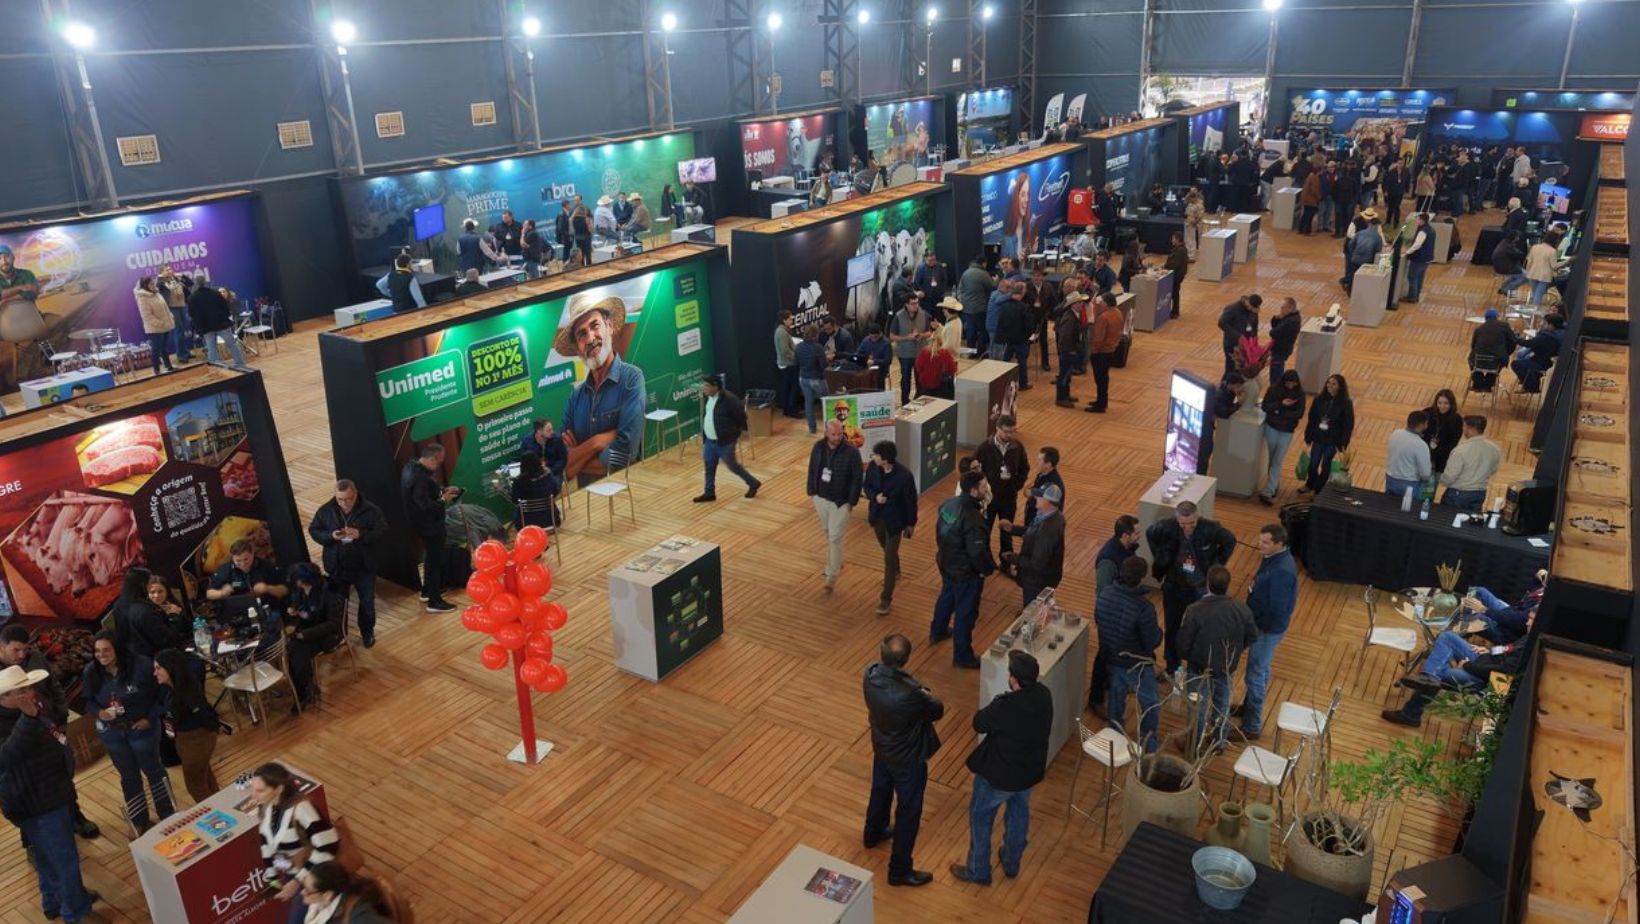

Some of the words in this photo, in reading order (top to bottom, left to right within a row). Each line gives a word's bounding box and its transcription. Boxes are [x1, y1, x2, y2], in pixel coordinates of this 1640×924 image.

[753, 148, 775, 166] SOMOS
[540, 182, 576, 201] inbra
[467, 198, 509, 216] PRIME
[126, 241, 208, 270] CUIDAMOS
[472, 340, 510, 358] DESCONTO
[510, 336, 520, 346] DE
[474, 345, 522, 376] 100%
[378, 360, 455, 398] Unimed
[476, 375, 491, 388] NO
[502, 362, 524, 380] MÊS
[424, 382, 456, 396] Presidente
[430, 389, 458, 402] Prudente
[477, 423, 484, 432] O
[514, 406, 533, 420] passo
[860, 407, 890, 418] saúde
[478, 434, 488, 442] do
[502, 422, 520, 436] plano
[521, 418, 530, 426] de
[150, 495, 163, 532] Conheça
[162, 474, 194, 490] origem
[211, 868, 270, 916] bette
